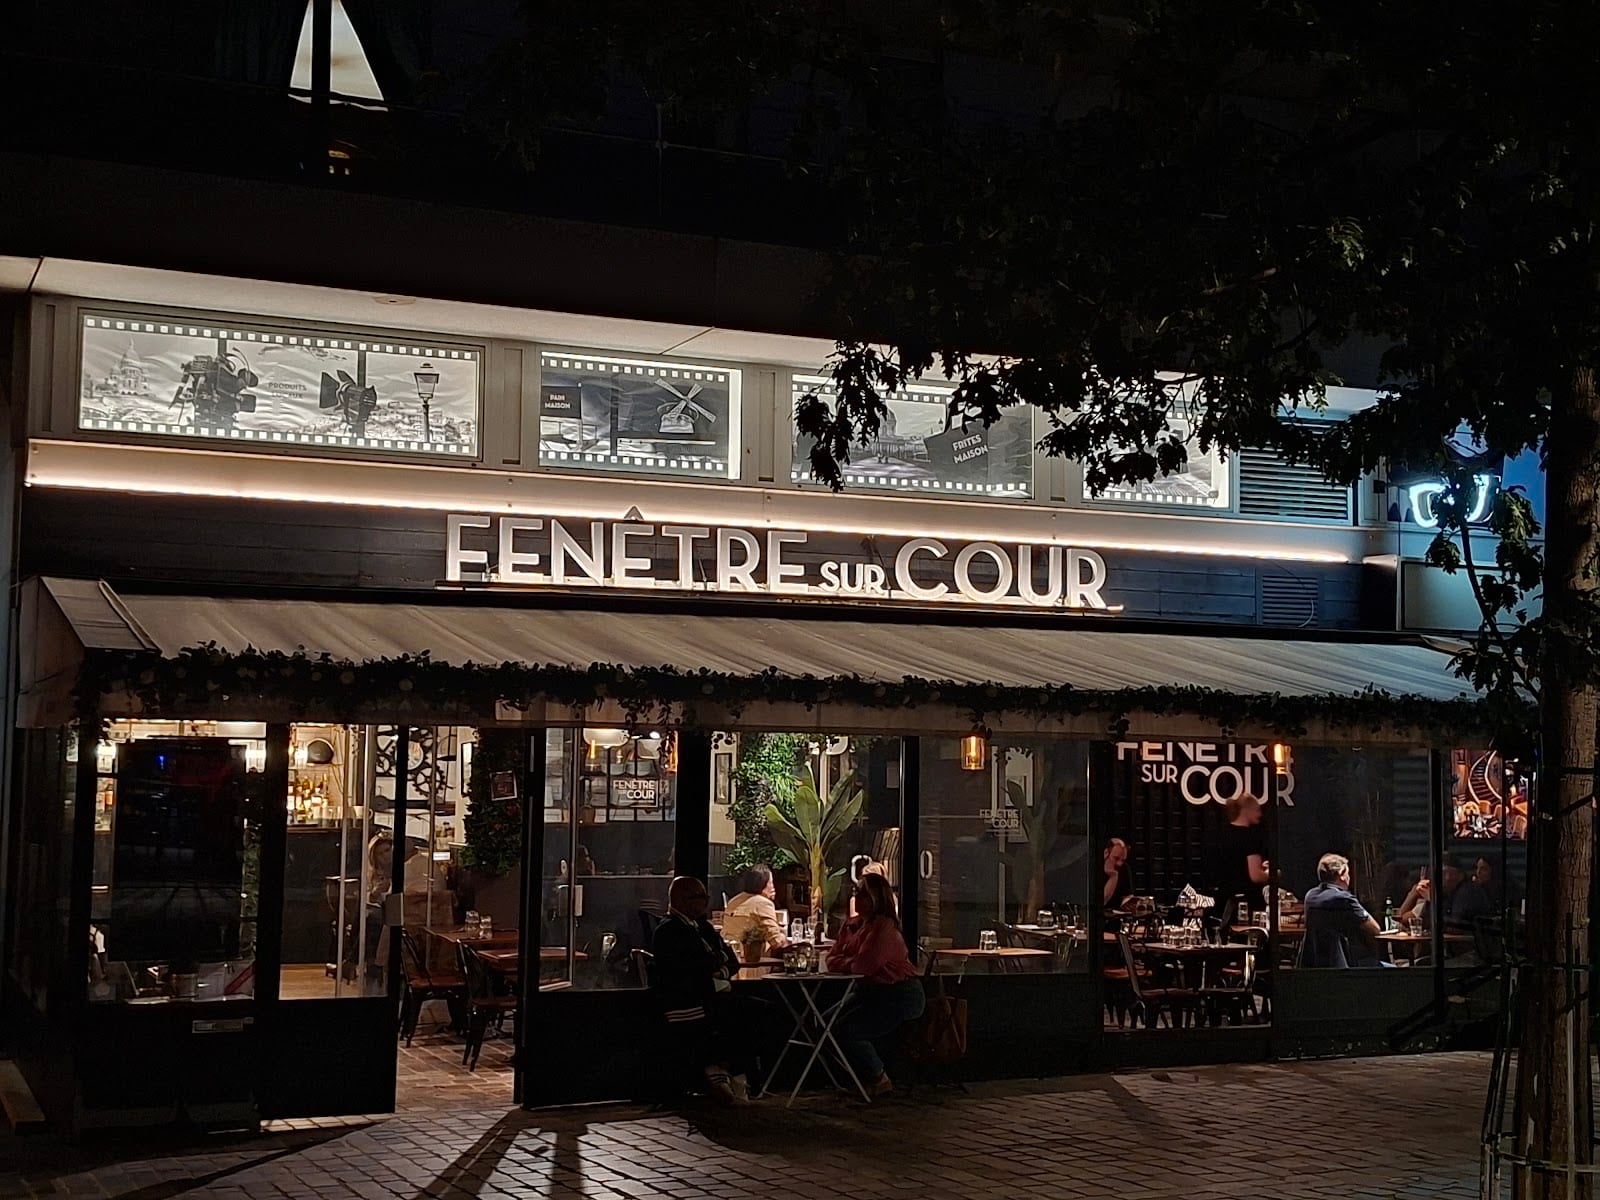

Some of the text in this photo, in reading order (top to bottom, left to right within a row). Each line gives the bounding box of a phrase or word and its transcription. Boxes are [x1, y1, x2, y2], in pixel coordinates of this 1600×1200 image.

[268, 382, 307, 391] PRODUITS
[952, 434, 982, 452] FRITES
[953, 445, 989, 464] MAISON
[445, 504, 1108, 609] FENÊTRE SUR COUR
[626, 789, 655, 799] COUR
[1141, 764, 1295, 807] SUR COUR
[992, 819, 1019, 828] COUR
